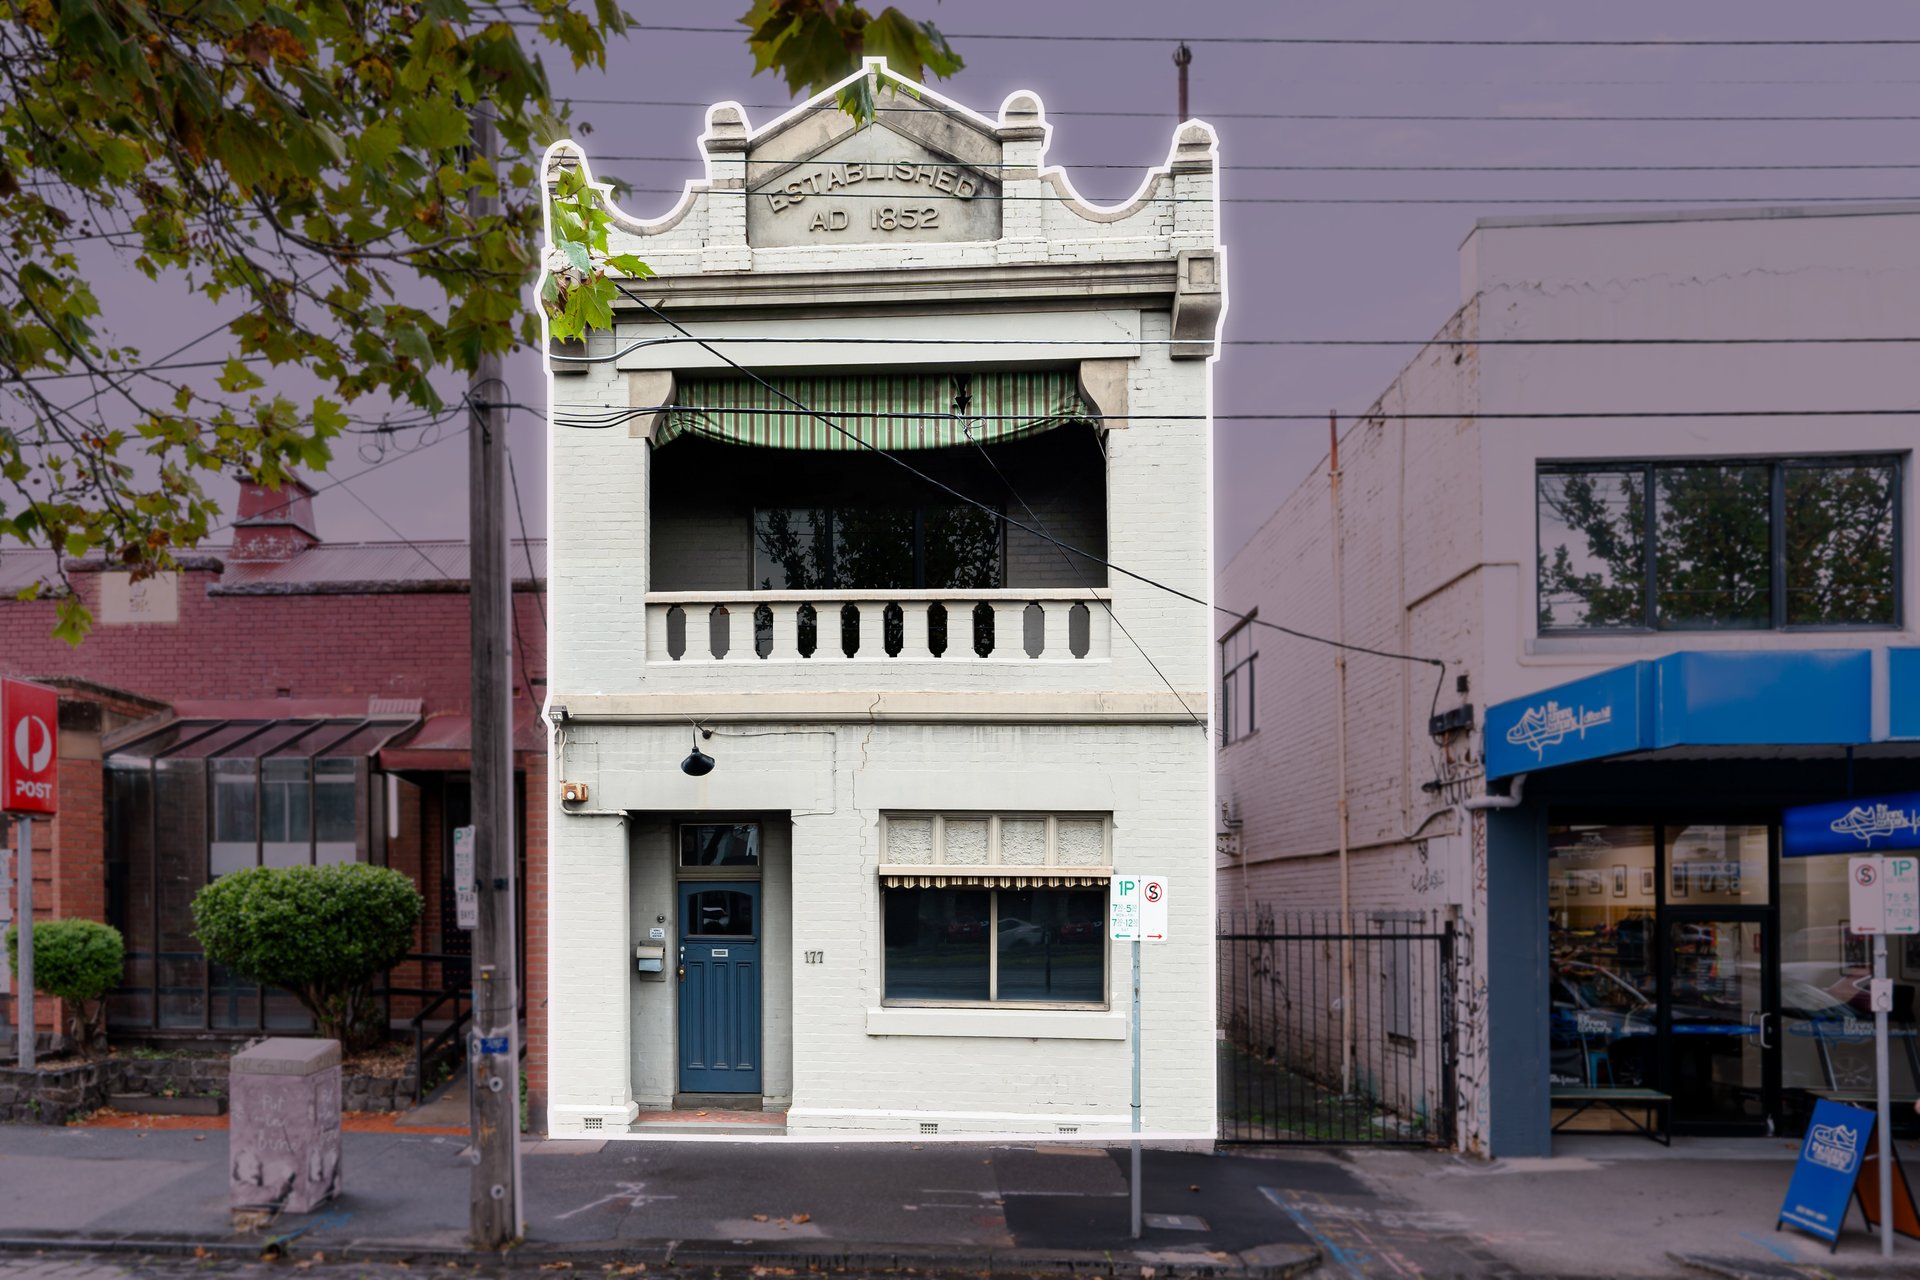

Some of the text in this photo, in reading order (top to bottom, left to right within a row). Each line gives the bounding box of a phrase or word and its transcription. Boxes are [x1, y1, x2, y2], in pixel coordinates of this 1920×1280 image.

[766, 158, 978, 213] ESTABLISHED
[809, 206, 939, 231] AD 1852
[15, 780, 52, 799] POST
[1892, 860, 1912, 876] 1P
[1119, 881, 1135, 896] 1P
[804, 951, 824, 964] 177
